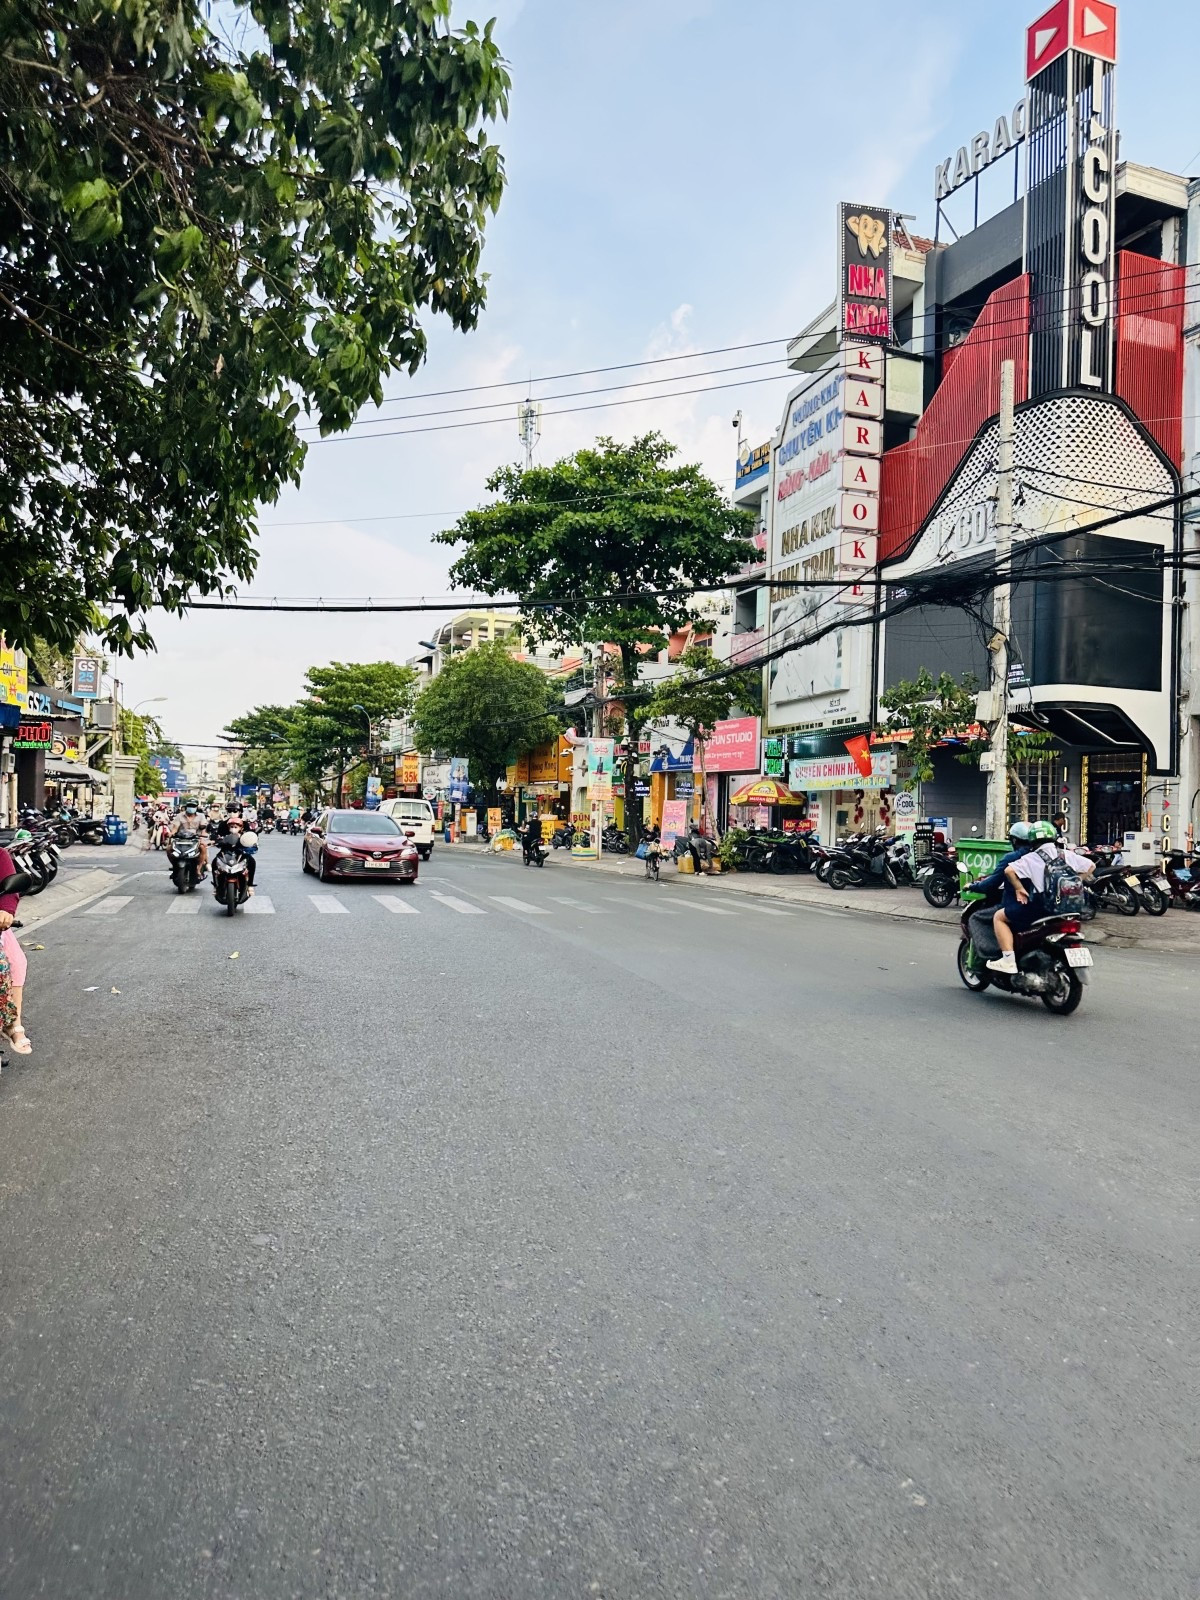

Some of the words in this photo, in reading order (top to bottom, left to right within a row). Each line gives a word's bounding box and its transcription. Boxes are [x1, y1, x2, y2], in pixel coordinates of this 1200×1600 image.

[848, 263, 887, 300] NHA
[844, 302, 889, 337] KHOA
[851, 350, 872, 597] KARAOKE
[781, 519, 809, 557] NHA
[78, 660, 96, 672] GS
[78, 672, 95, 682] 25
[27, 690, 51, 715] GS25
[726, 731, 752, 744] STUDIO
[403, 771, 418, 783] 35k
